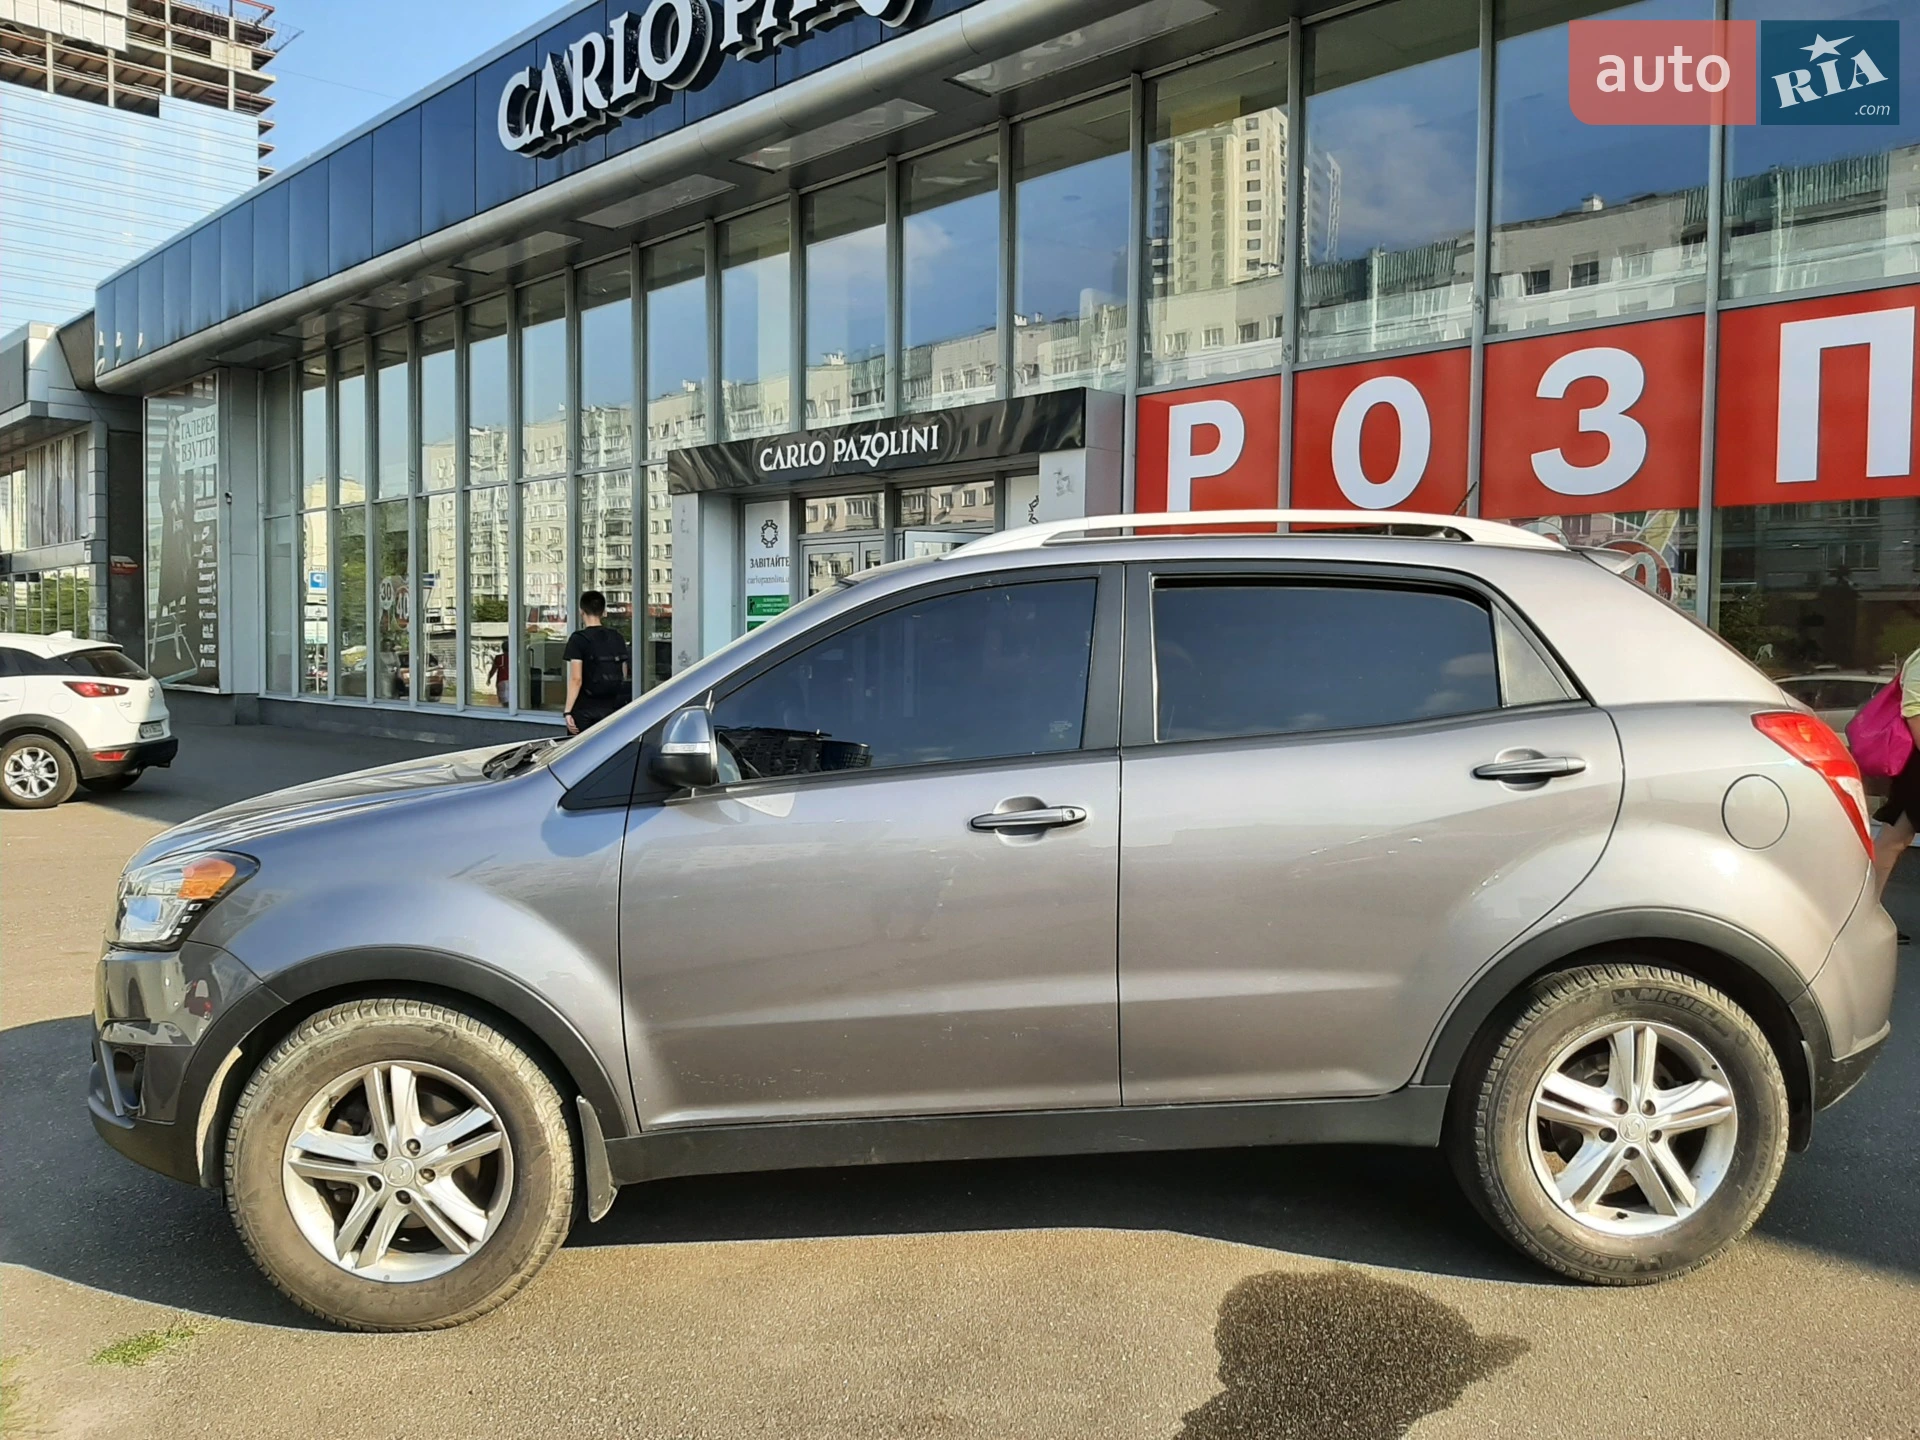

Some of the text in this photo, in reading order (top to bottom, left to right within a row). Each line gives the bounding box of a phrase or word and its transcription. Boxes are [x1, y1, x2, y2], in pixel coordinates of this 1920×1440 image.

[498, 0, 694, 152] CARLO
[181, 413, 216, 440] ГАЛЕРЕЯ
[181, 436, 216, 465] ВЗУТТЯ
[760, 425, 940, 472] CARLO PAZOLINI
